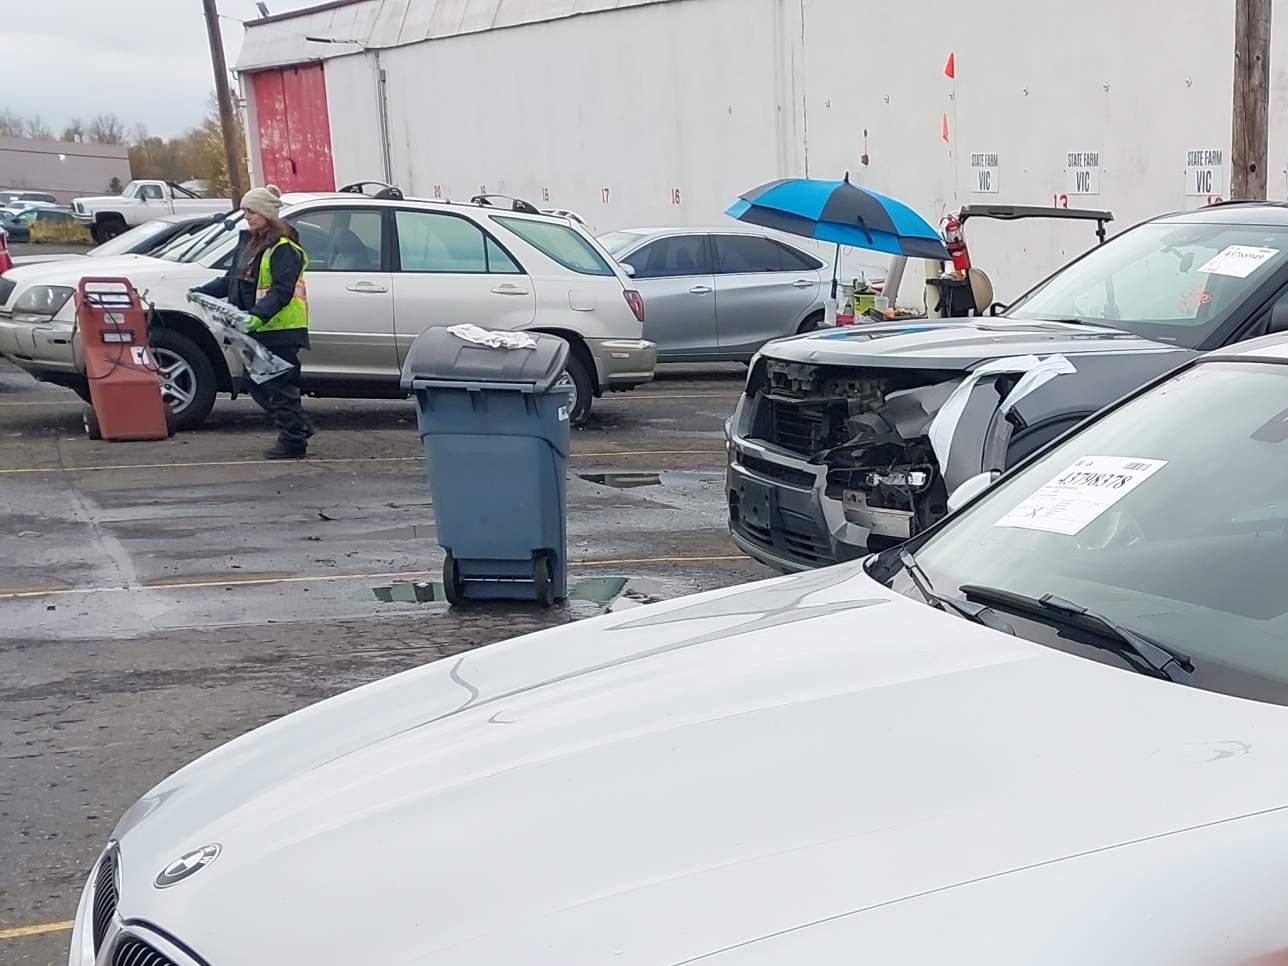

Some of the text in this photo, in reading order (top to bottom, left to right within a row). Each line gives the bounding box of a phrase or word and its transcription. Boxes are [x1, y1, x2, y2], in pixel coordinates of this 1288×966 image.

[971, 154, 998, 167] STATE FARM
[1067, 153, 1099, 167] STATE FARM
[1187, 150, 1222, 166] STATE FARM
[979, 171, 991, 190] VIC
[1076, 171, 1090, 192] VIC
[1196, 170, 1212, 193] VIC
[542, 188, 550, 202] 18
[601, 187, 610, 204] 17
[671, 188, 681, 205] 16
